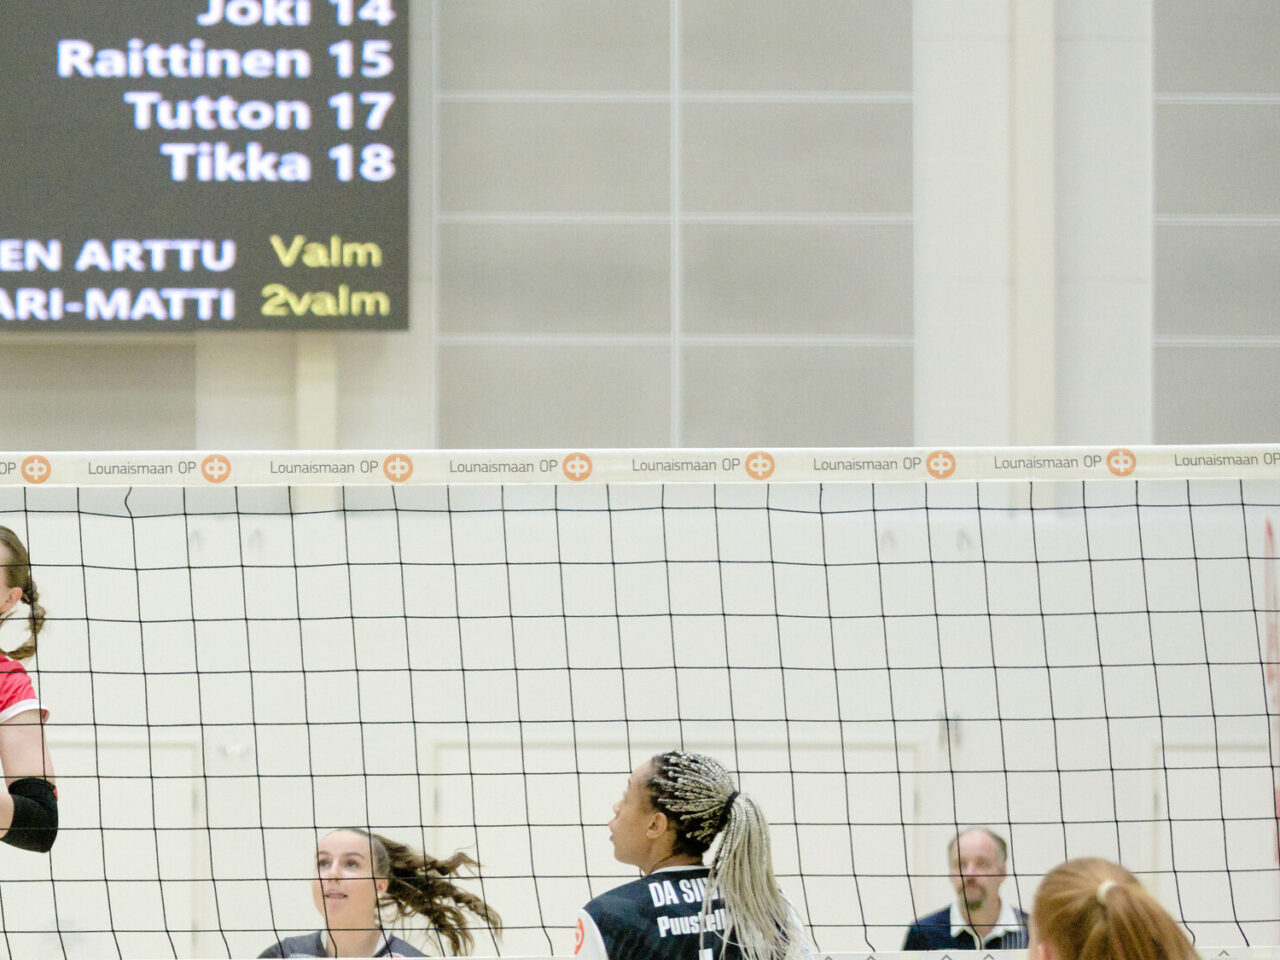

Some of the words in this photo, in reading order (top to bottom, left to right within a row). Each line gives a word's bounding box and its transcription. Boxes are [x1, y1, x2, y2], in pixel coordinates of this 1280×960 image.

[329, 0, 395, 26] 14
[58, 39, 310, 78] Raittinen
[329, 40, 394, 78] 15
[124, 92, 310, 129] Tutton
[329, 92, 395, 129] 17
[160, 142, 310, 181] Tikka
[329, 143, 395, 181] 18
[75, 239, 236, 271] ARTTU
[270, 235, 382, 267] Valm
[261, 284, 390, 316] 2valm
[87, 461, 173, 475] Lounaismaan
[177, 460, 197, 475] OP
[269, 460, 355, 474] Lounaismaan
[359, 460, 379, 474] OP
[449, 459, 535, 473] Lounaismaan
[538, 459, 559, 473] OP
[631, 458, 717, 472] Lounaismaan
[721, 457, 741, 471] OP
[813, 457, 899, 471] Lounaismaan
[902, 456, 923, 471] OP
[994, 455, 1079, 470] Lounaismaan
[1083, 454, 1103, 469] OP
[1174, 453, 1260, 467] Lounaismaan
[648, 880, 680, 908] DA
[657, 908, 726, 938] Puustell
